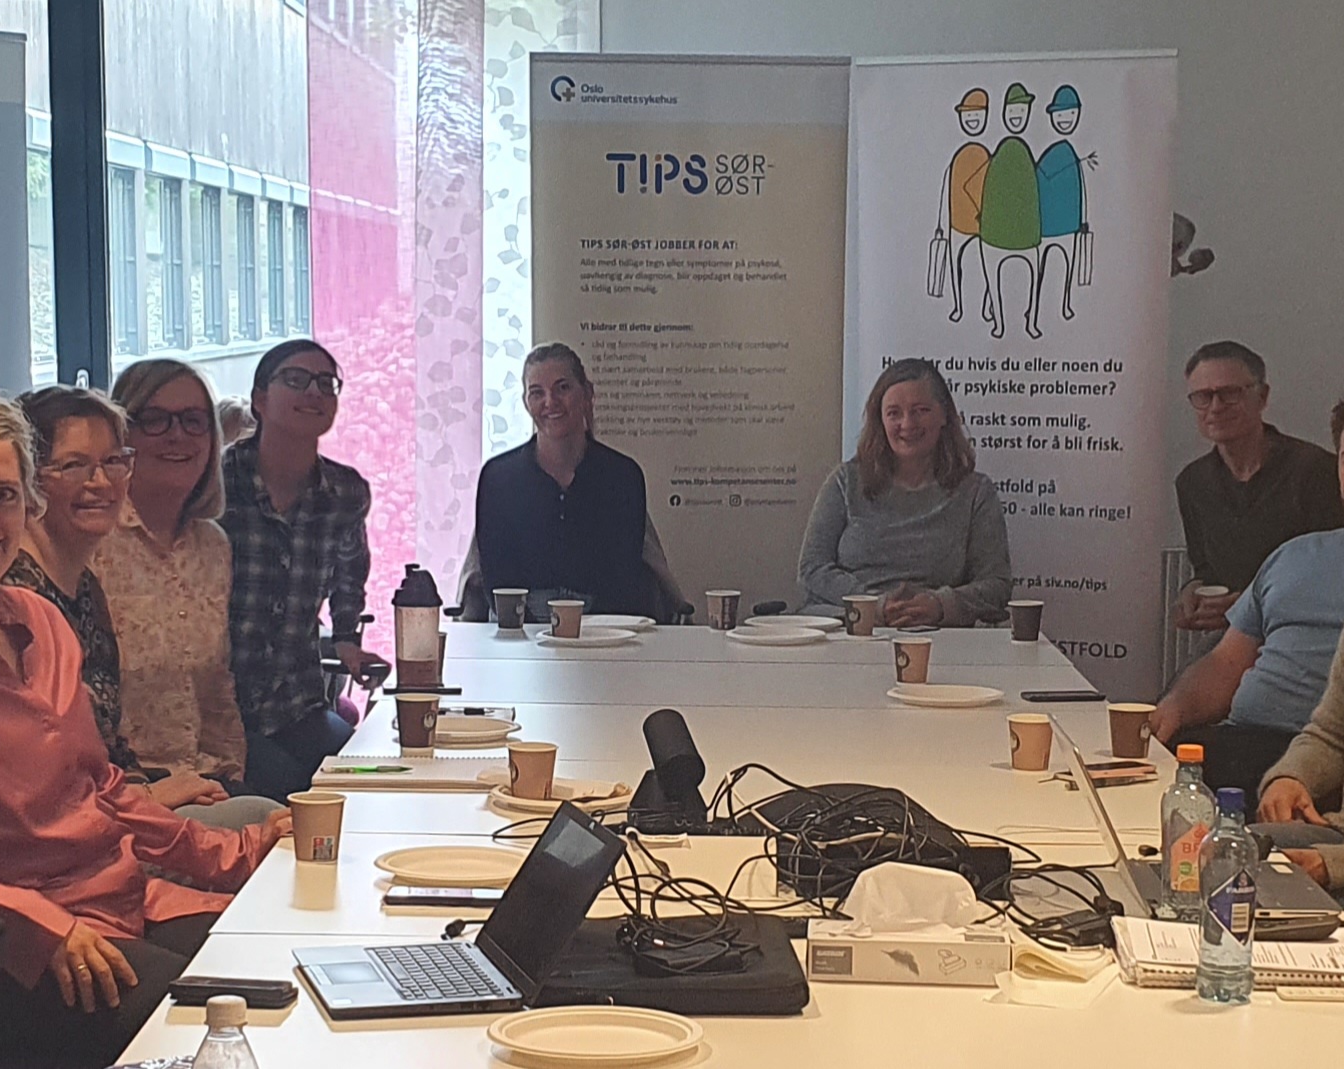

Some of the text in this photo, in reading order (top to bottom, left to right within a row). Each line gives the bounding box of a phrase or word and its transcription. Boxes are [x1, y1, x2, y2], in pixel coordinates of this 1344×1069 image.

[581, 84, 604, 93] Oslo
[581, 95, 678, 105] universitetssykehus
[715, 154, 775, 174] SØR-
[715, 175, 765, 195] ØST
[580, 239, 738, 250] TIPS SØR-ØST JOBBER FOR AT:
[580, 322, 694, 334] Vi bidrar til dette gjennom:
[945, 357, 964, 371] du
[968, 357, 997, 371] hvis
[1001, 357, 1020, 371] du
[1024, 357, 1057, 372] eller
[1061, 361, 1099, 373] noen
[1103, 358, 1123, 373] du
[964, 379, 1026, 397] psykiske
[1029, 380, 1117, 397] problemer?
[970, 412, 1006, 426] raskt
[1010, 415, 1041, 427] som
[1045, 413, 1091, 431] mulig.
[981, 435, 1022, 449] størst
[1026, 434, 1048, 449] for
[1051, 434, 1060, 449] å
[1064, 435, 1083, 450] bli
[1086, 436, 1123, 451] frisk.
[1037, 479, 1056, 497] på
[1029, 503, 1056, 517] alle
[1059, 504, 1085, 518] kan
[1088, 505, 1131, 521] ringe!
[1027, 575, 1042, 588] på
[1044, 577, 1108, 592] siv.no/tips
